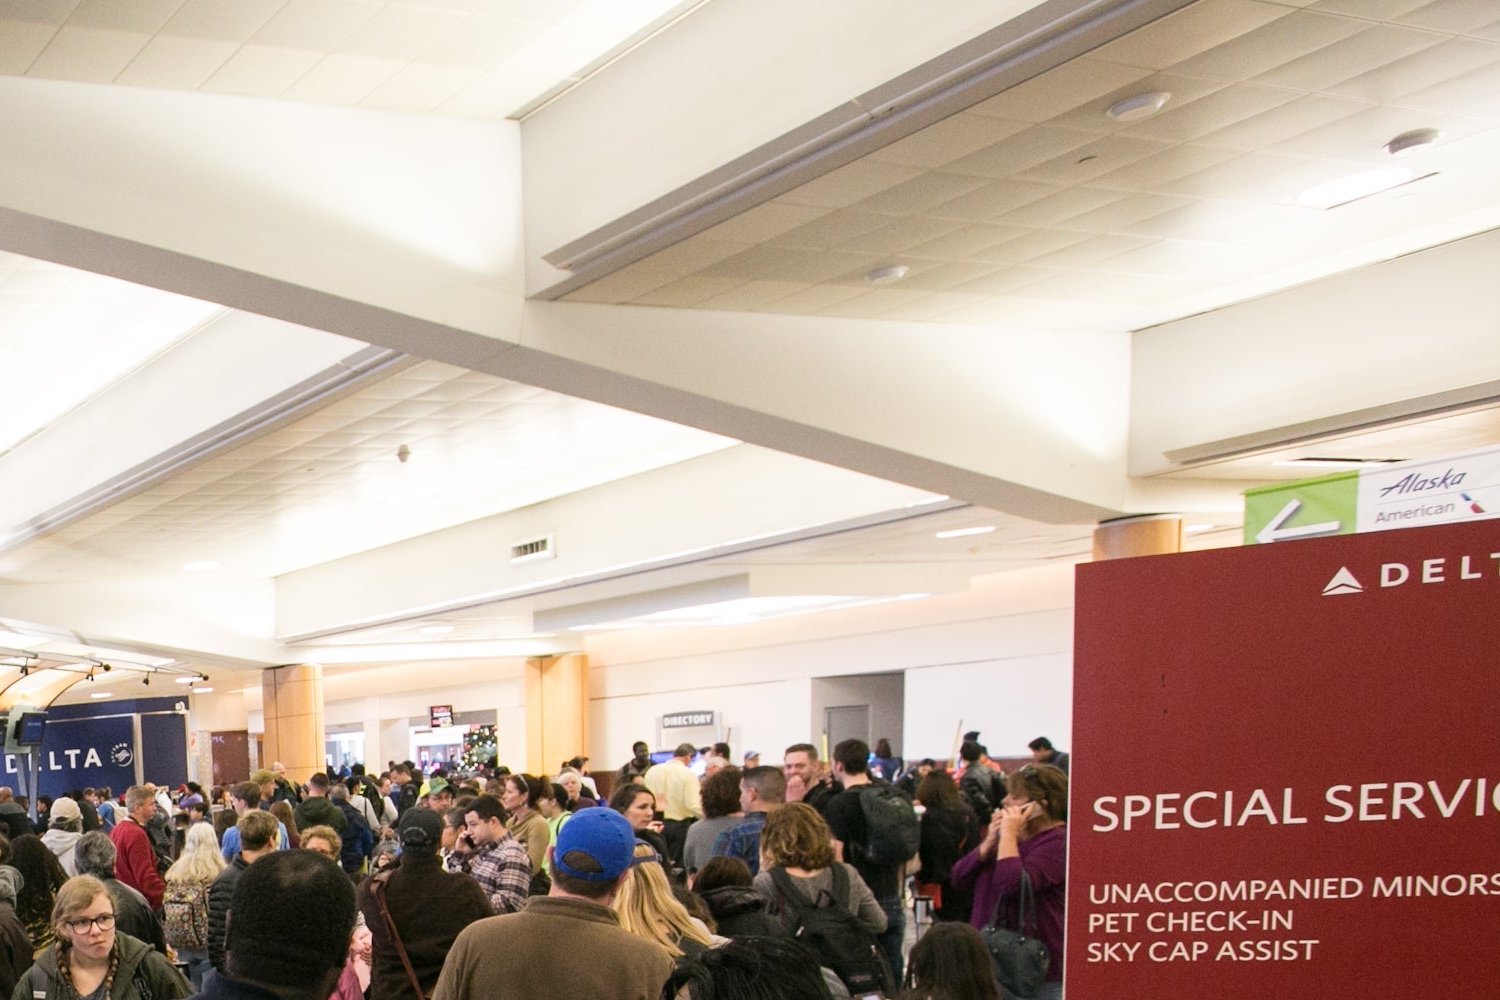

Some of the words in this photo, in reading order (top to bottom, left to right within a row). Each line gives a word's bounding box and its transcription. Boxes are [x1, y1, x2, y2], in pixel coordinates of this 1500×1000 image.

[1380, 468, 1468, 498] Alaska
[1374, 502, 1456, 523] American
[663, 713, 713, 727] DIRECTORY
[1092, 787, 1308, 832] SPECIAL
[1323, 777, 1500, 823] SERVI
[1089, 877, 1364, 905] UNACCOMPANIED
[1088, 912, 1140, 934] PET
[1145, 909, 1294, 933] CHECK-IN
[1086, 942, 1142, 963] SKY
[1148, 941, 1209, 963] CAP
[1215, 940, 1320, 962] ASSIST
